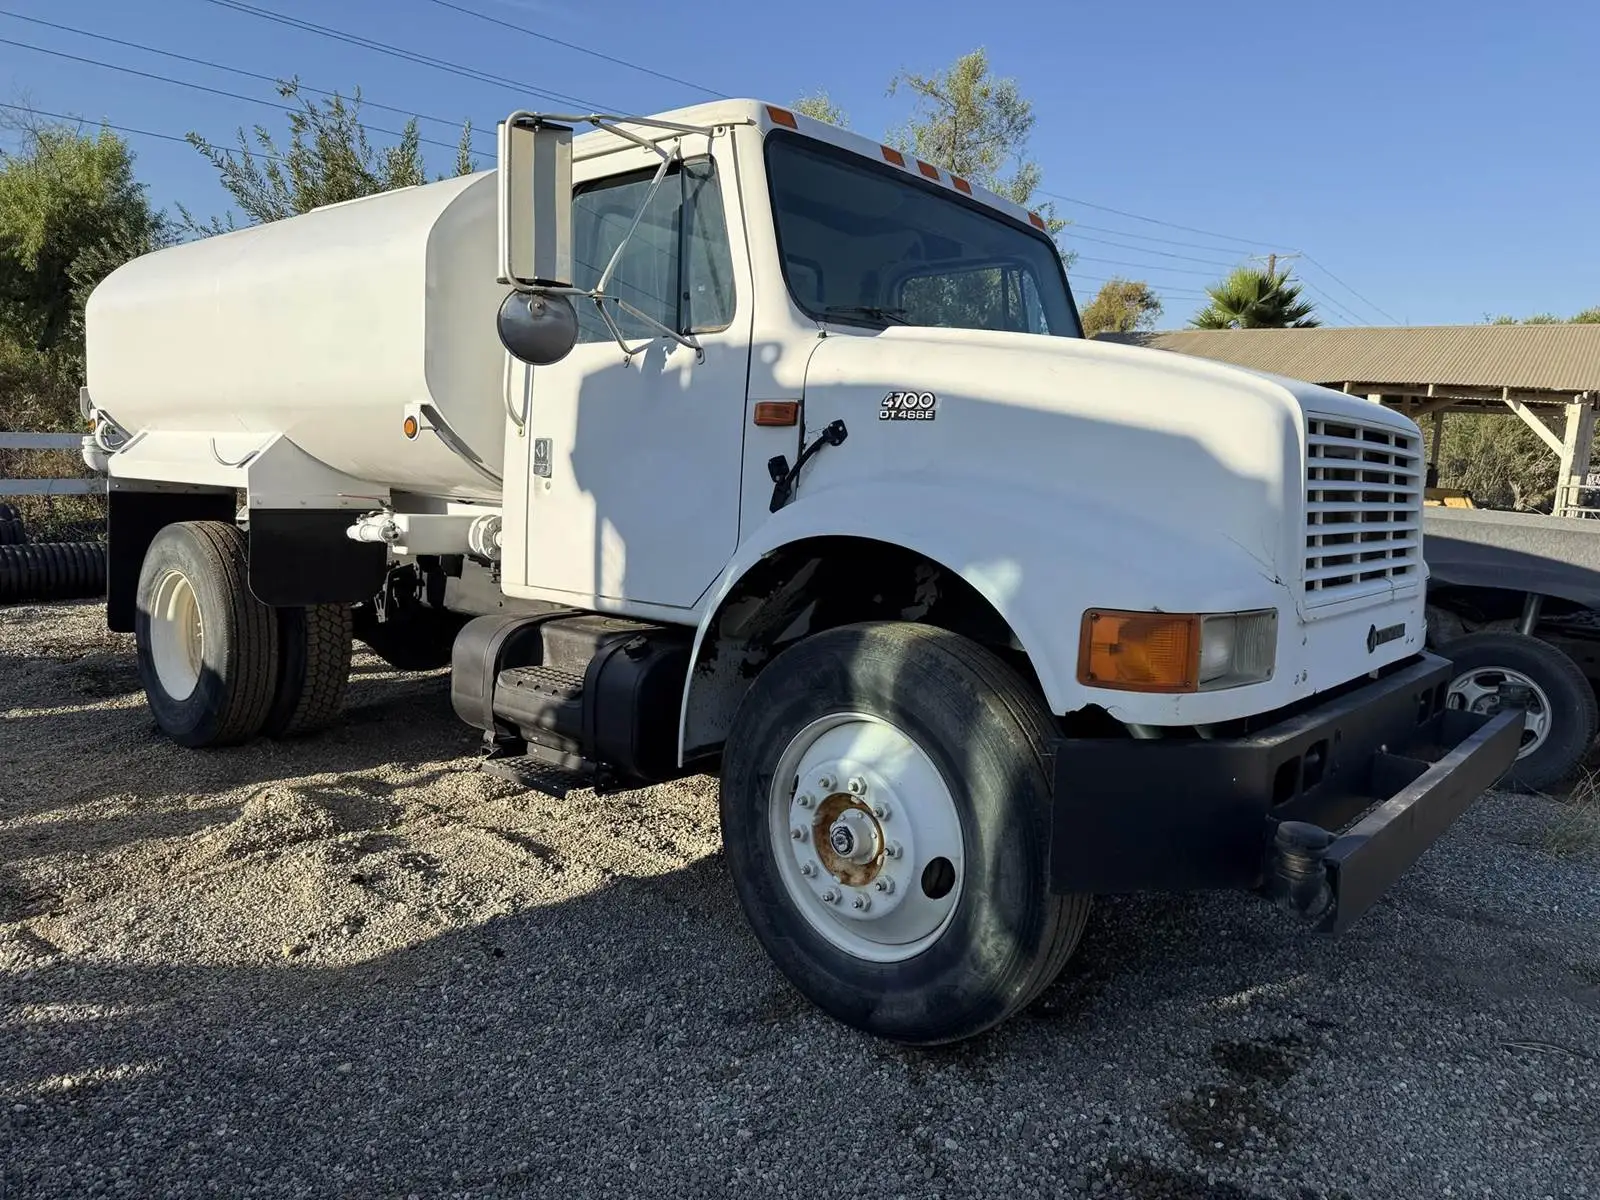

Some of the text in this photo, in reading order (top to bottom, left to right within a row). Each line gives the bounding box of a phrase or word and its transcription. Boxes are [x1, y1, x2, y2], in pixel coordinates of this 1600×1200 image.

[881, 391, 935, 409] 4700
[879, 410, 934, 419] DT 466E
